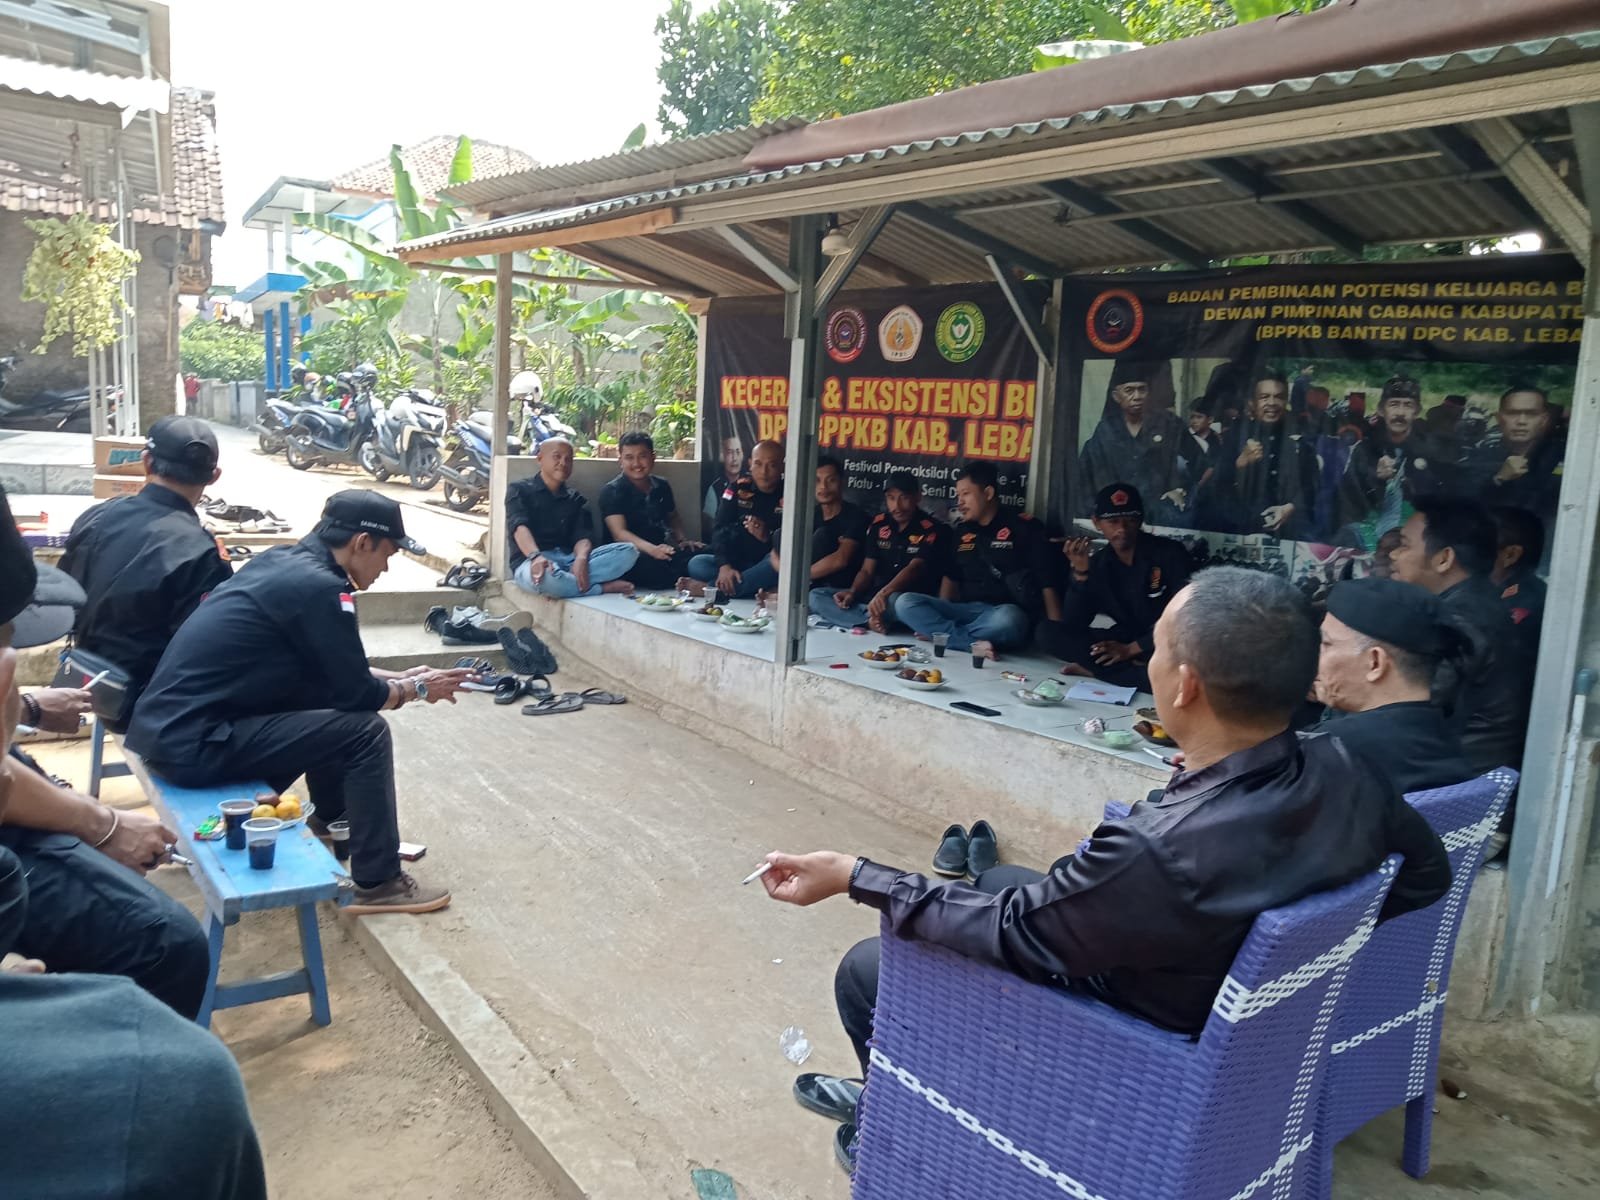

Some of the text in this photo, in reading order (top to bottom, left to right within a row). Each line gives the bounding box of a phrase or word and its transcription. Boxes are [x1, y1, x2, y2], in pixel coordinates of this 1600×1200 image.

[1167, 288, 1224, 304] BADAN
[1229, 284, 1336, 301] PEMBINAAN
[1342, 282, 1428, 299] POTENSI
[1434, 280, 1558, 297] KELUARGA
[1204, 306, 1266, 321] DEWAN
[1271, 304, 1363, 319] PIMPINAN
[1369, 304, 1454, 319] CABANG
[1256, 324, 1322, 341] (BPPKB
[1327, 326, 1406, 341] BANTEN
[1413, 326, 1457, 341] DPC
[1463, 327, 1516, 343] KAB.
[721, 377, 789, 408] KECER
[822, 377, 842, 410] &
[848, 378, 999, 418] EKSISTENSI
[819, 414, 887, 449] PPKB
[893, 418, 958, 454] KAB.
[844, 459, 882, 474] Festival
[921, 483, 946, 498] Seni
